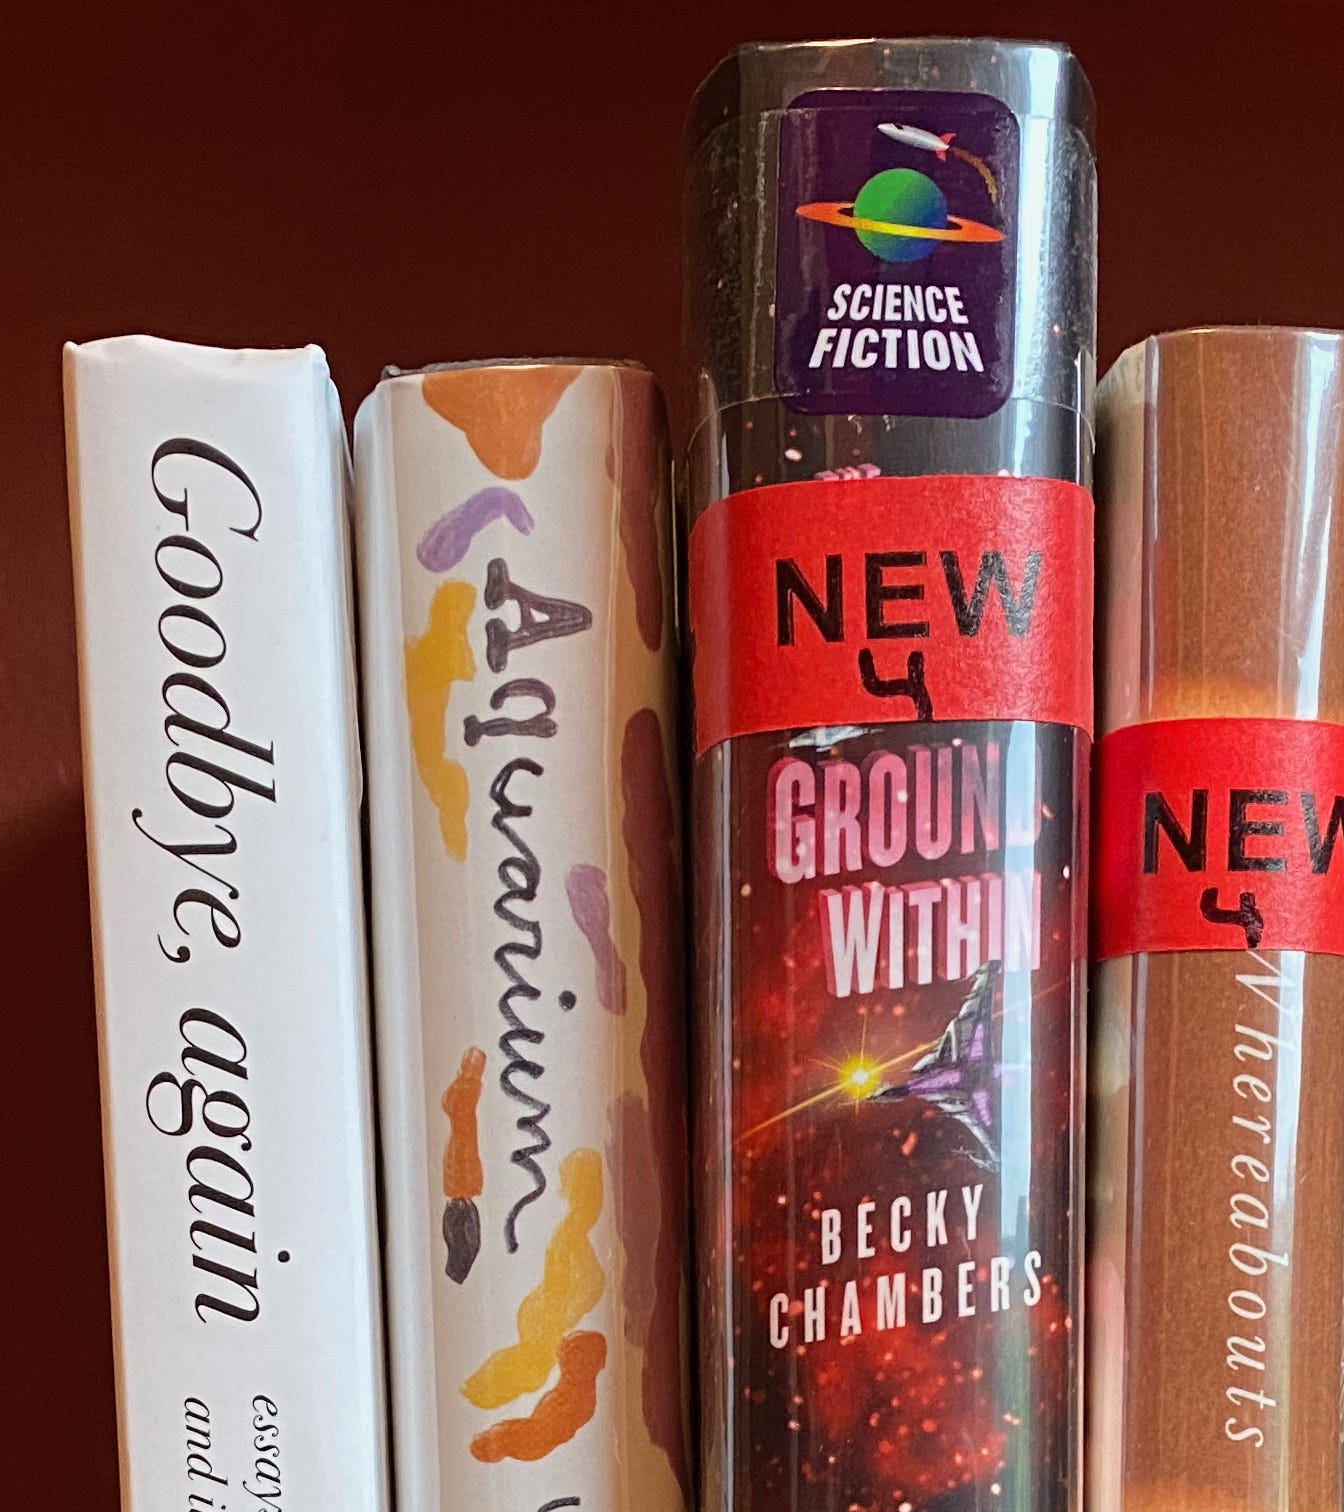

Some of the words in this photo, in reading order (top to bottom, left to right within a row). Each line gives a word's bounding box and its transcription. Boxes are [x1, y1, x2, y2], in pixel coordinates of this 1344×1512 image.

[827, 283, 969, 324] SCIENCE
[808, 328, 984, 373] FICTION
[775, 550, 1044, 647] NEW
[131, 436, 277, 964] Goodbye,
[858, 648, 935, 722] 4
[462, 556, 594, 1255] Aquarium
[818, 871, 1043, 998] WITHIN
[1200, 886, 1264, 949] 4
[146, 1007, 292, 1325] again
[821, 1184, 984, 1266] BECKY
[769, 1251, 1043, 1349] CHAMBERS
[183, 1396, 229, 1486] and
